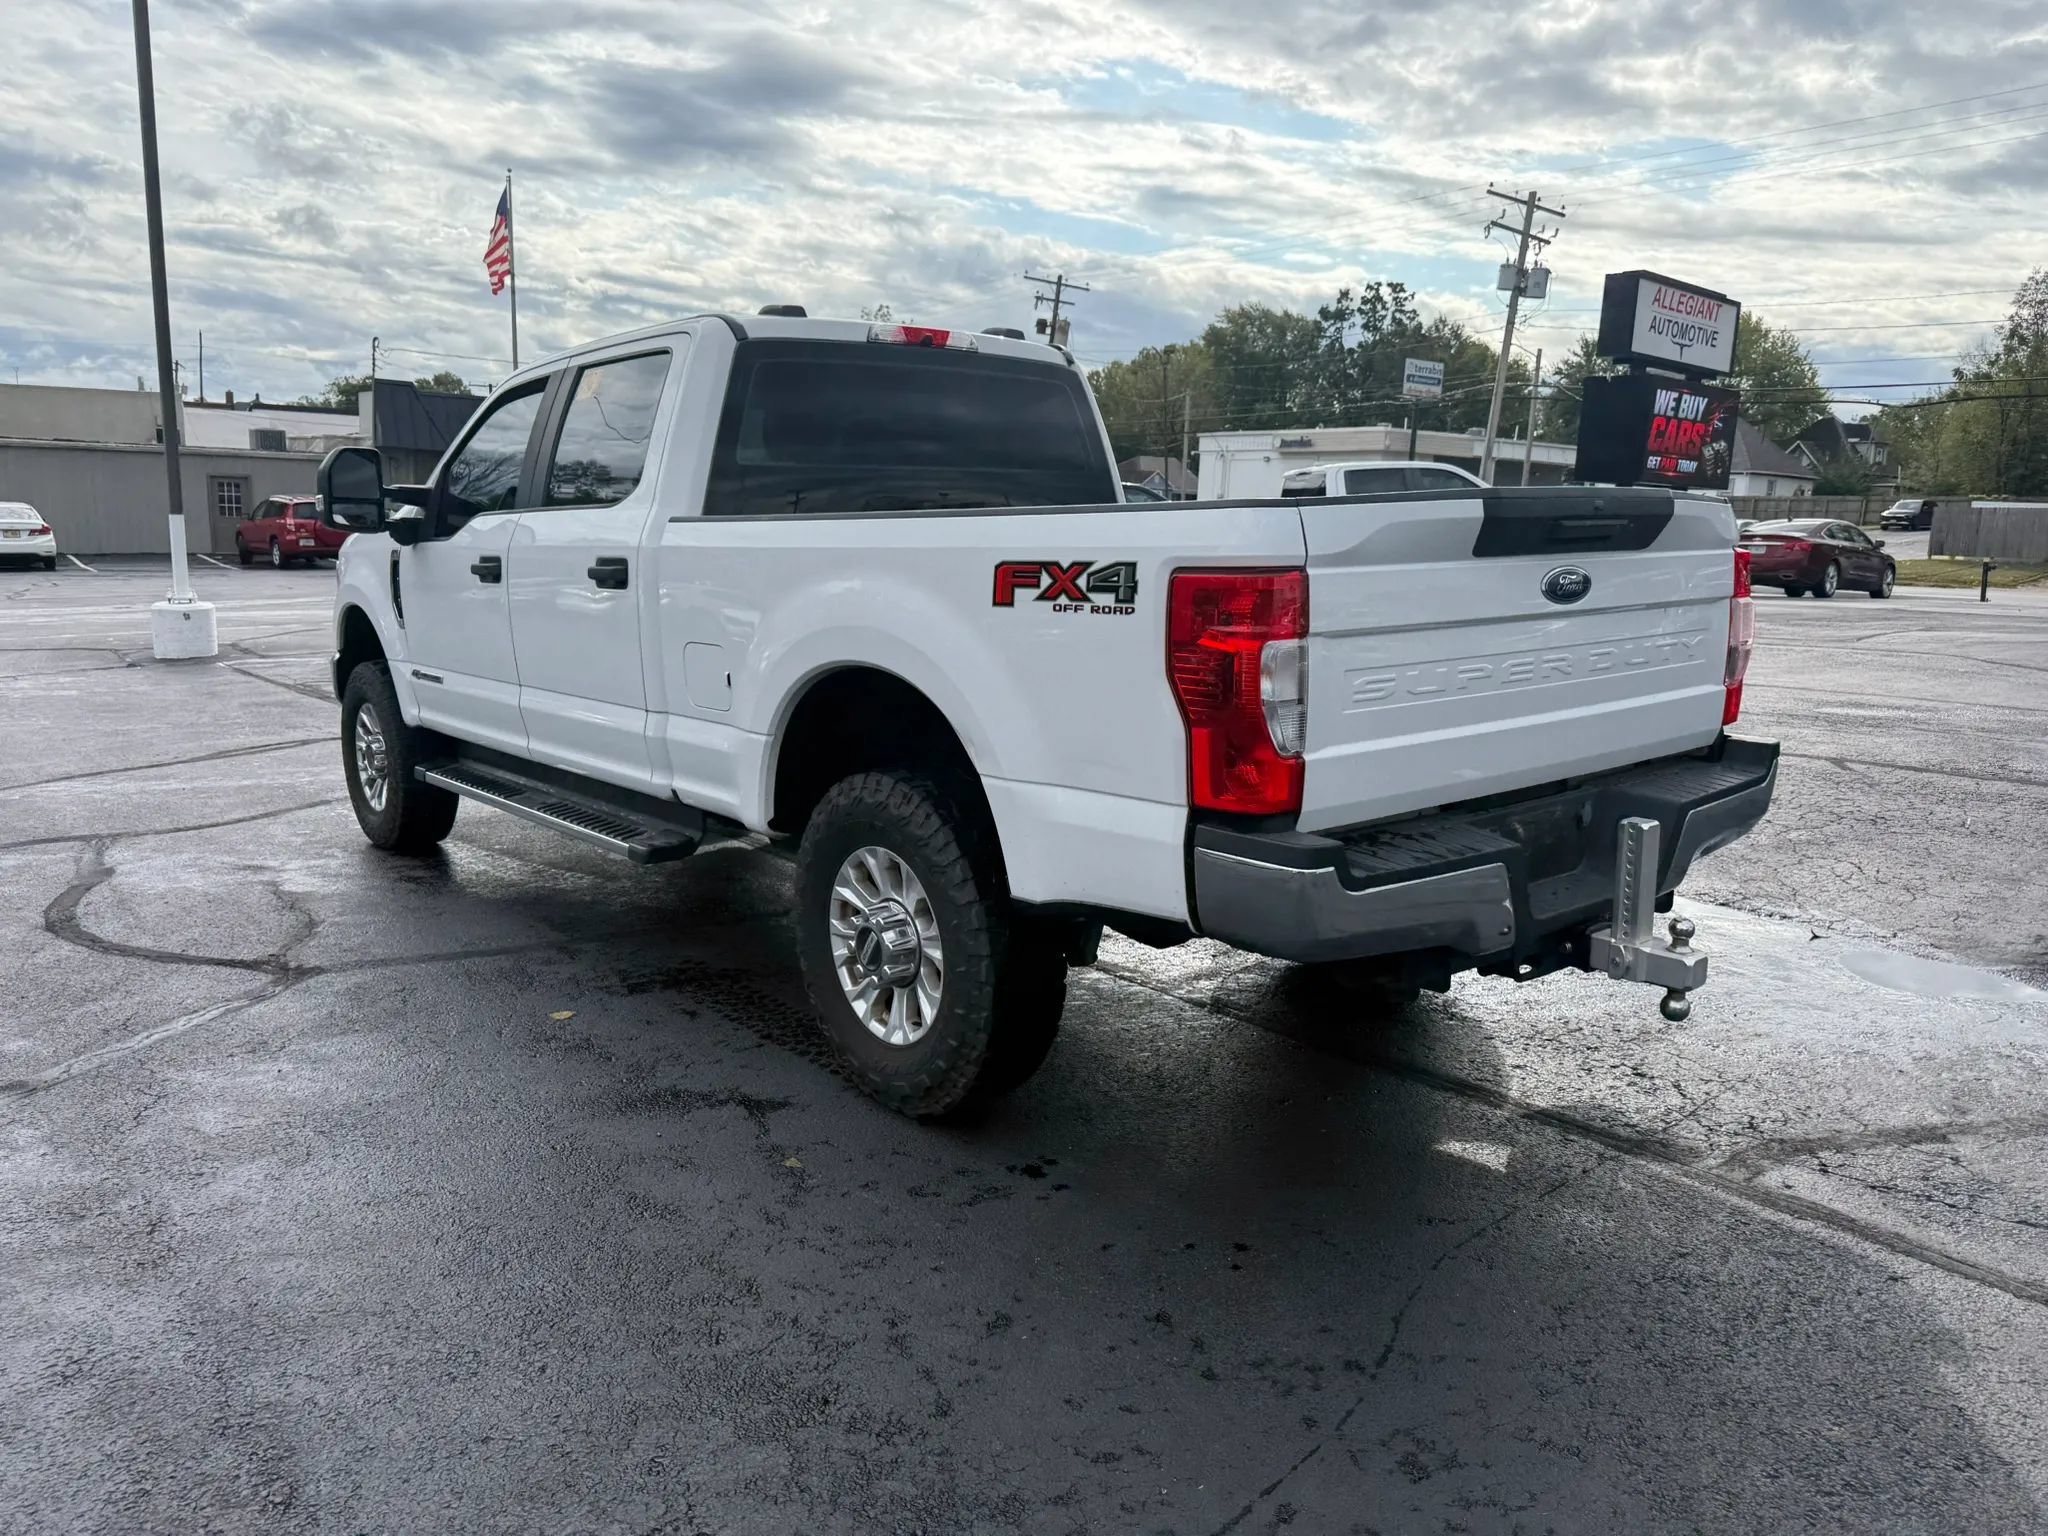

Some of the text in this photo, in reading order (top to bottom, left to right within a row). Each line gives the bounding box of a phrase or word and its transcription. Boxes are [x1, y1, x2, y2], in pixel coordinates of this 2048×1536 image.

[1651, 286, 1723, 322] ALLEGIANT
[1648, 315, 1719, 348] AUTOMOTIVE
[1653, 388, 1709, 421] WE BUY
[1647, 416, 1706, 456] CARS
[1646, 455, 1661, 470] GET
[1676, 459, 1698, 473] TODAY
[992, 561, 1138, 607] FX4
[1557, 574, 1583, 595] Ford
[1052, 603, 1136, 616] OFF ROAD
[1352, 635, 1704, 703] SUPER DUTY
